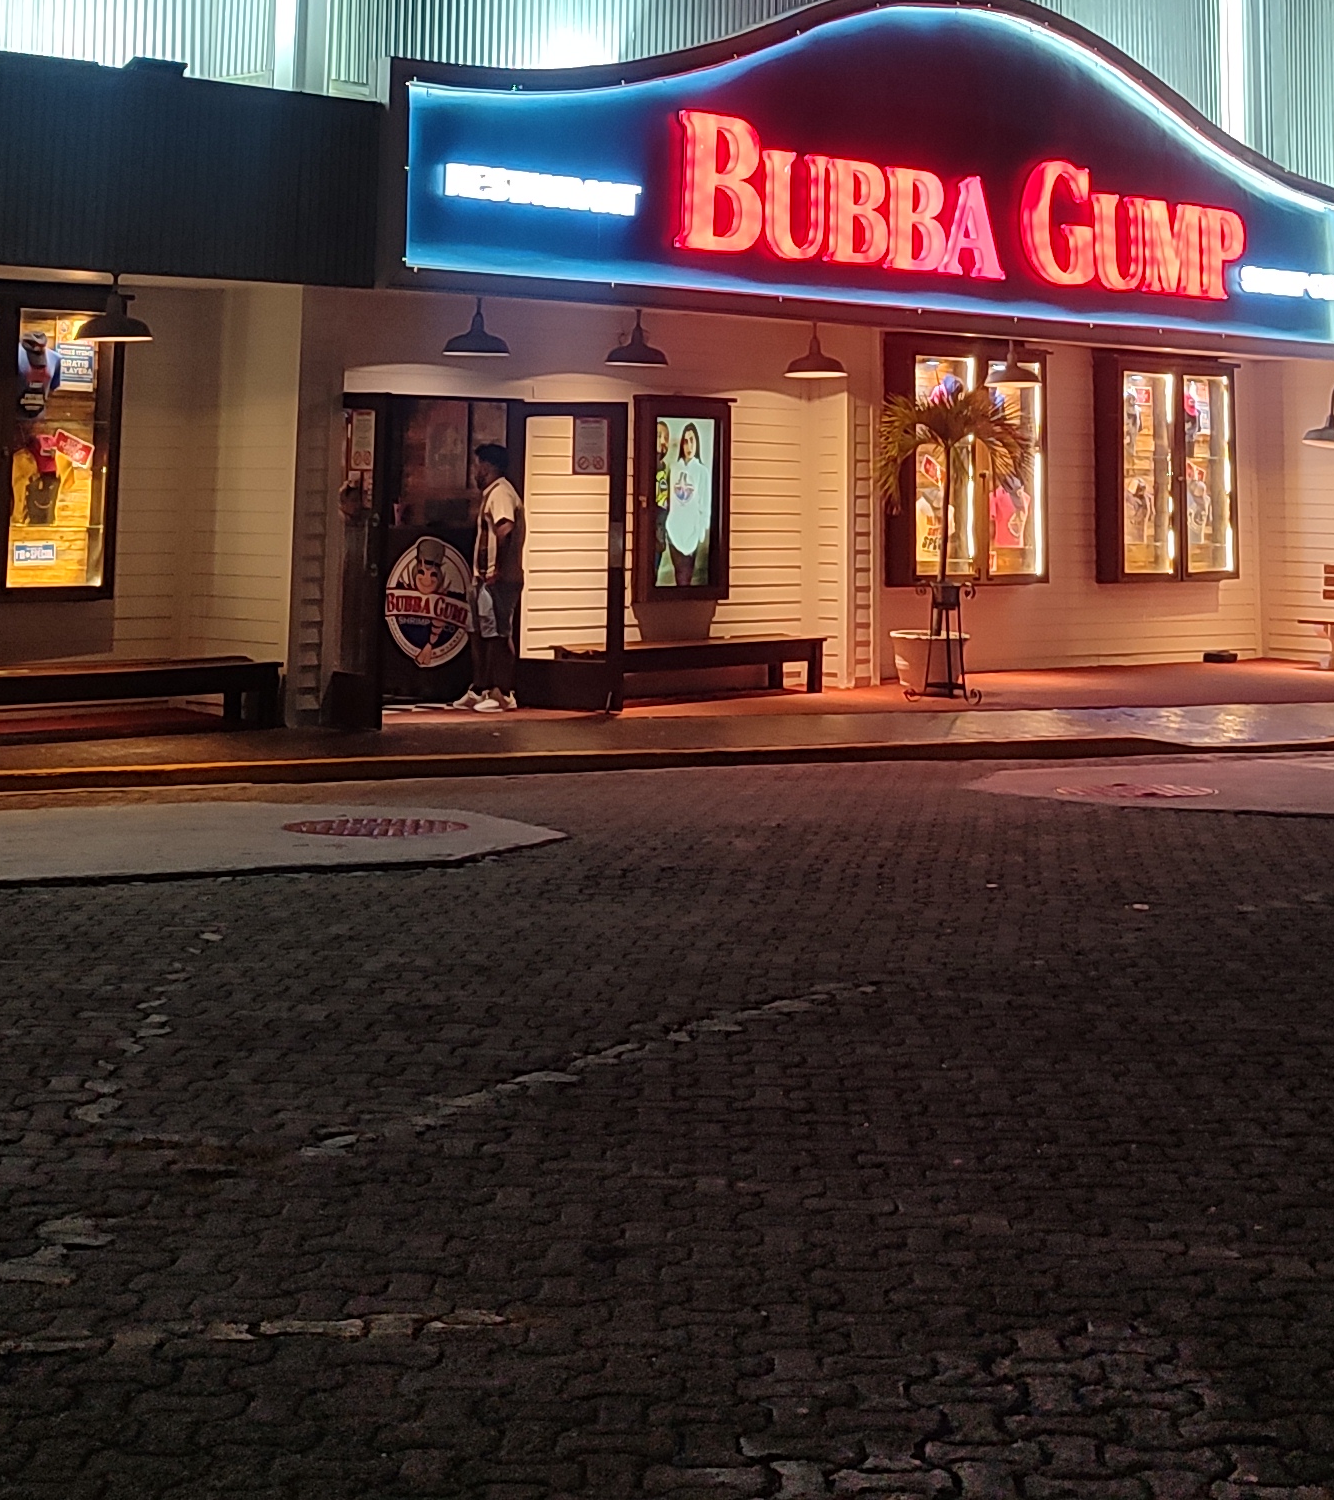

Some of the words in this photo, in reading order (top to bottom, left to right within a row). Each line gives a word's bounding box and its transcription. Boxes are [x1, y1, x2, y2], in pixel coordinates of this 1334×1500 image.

[674, 109, 1007, 281] BUBBA
[1019, 159, 1248, 300] GUMP
[387, 592, 431, 615] BUBBA
[398, 615, 431, 626] SHRIMP
